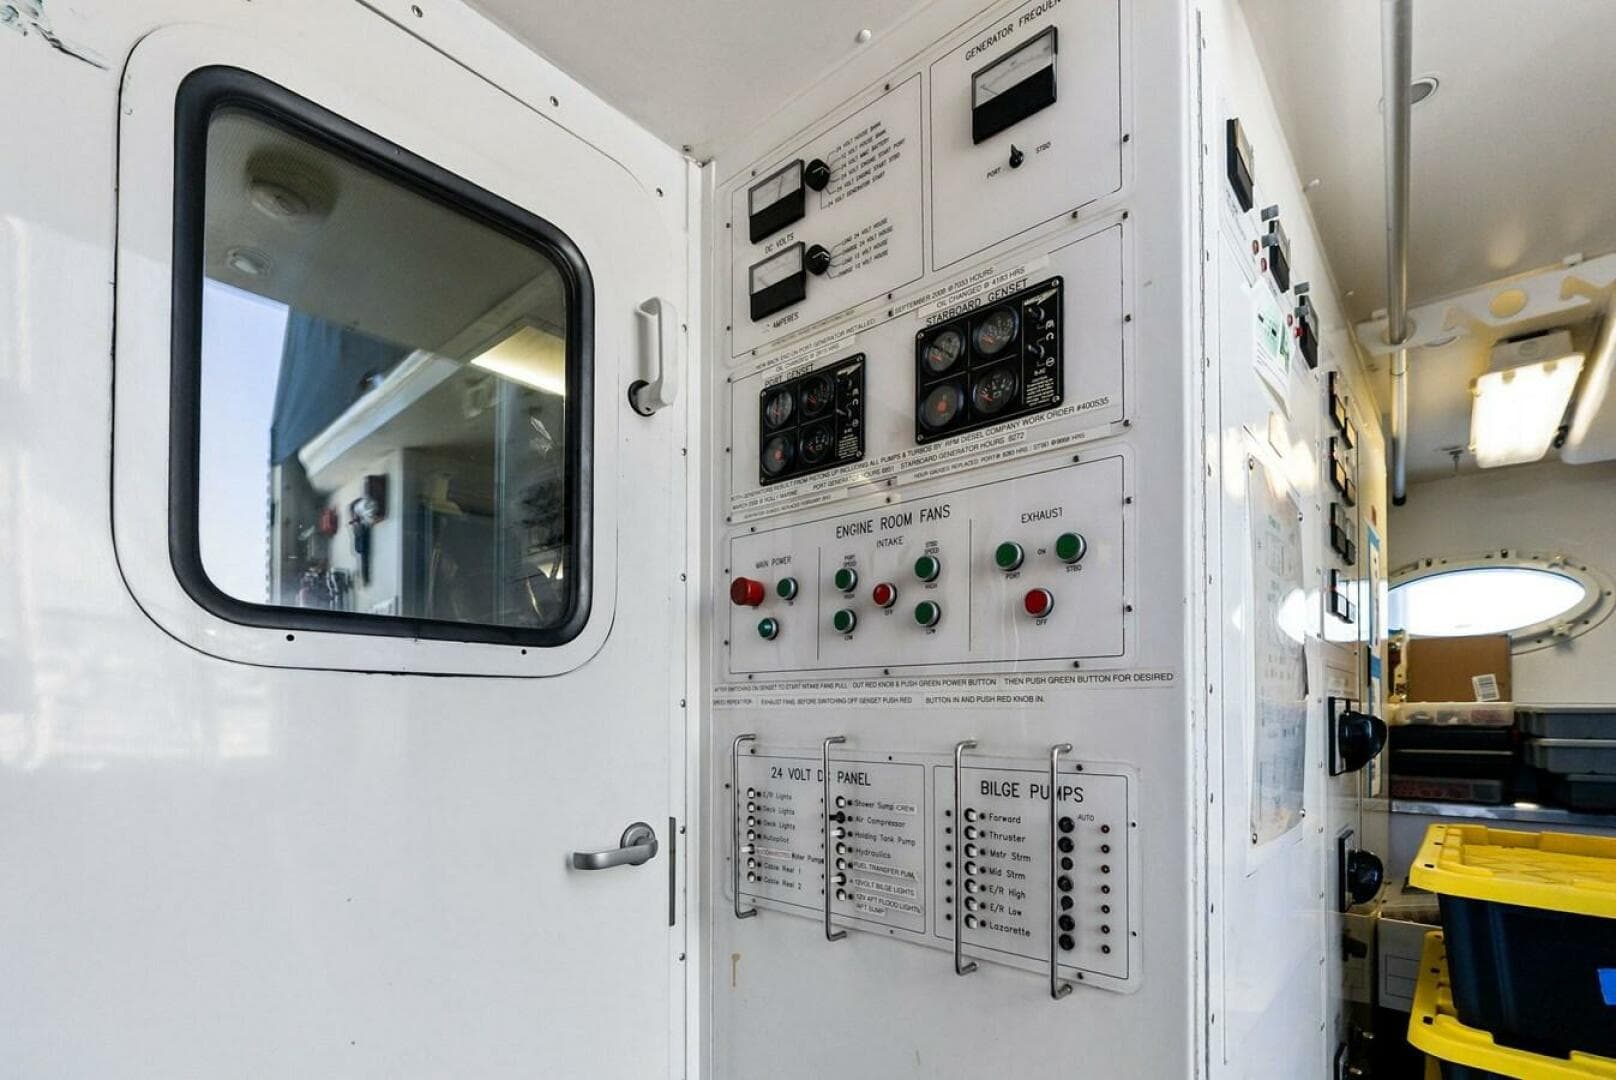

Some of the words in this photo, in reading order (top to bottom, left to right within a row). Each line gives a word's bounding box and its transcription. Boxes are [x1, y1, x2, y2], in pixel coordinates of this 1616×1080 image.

[966, 24, 1014, 61] GENERATOR
[764, 244, 773, 254] DC
[776, 233, 794, 248] VOLTS
[948, 284, 982, 303] CHANGED
[1009, 266, 1025, 277] HRS
[926, 298, 981, 326] STARBOARD
[988, 278, 1028, 301] GENSET
[773, 312, 799, 329] AMPERES
[814, 331, 845, 348] GENERATOR
[765, 374, 782, 388] PORT
[786, 363, 814, 380] GENSET
[880, 452, 901, 462] PUMPS
[985, 421, 1020, 435] COMPANY
[1022, 414, 1045, 426] WORK
[1046, 405, 1074, 419] ORDER
[900, 454, 937, 468] STARBOARD
[938, 443, 979, 459] GENERATOR
[980, 437, 1004, 449] HOURS
[836, 519, 874, 539] ENGINE
[880, 512, 912, 532] ROOM
[920, 504, 950, 523] FANS
[1021, 507, 1063, 524] EXHAUST
[876, 536, 904, 548] INTAKE
[771, 555, 792, 566] POWER
[1077, 675, 1110, 683] BUTTON
[1112, 673, 1131, 681] FOR
[1134, 672, 1173, 681] DESIRED
[771, 766, 784, 779] 24
[788, 768, 811, 781] VOLT
[818, 769, 830, 783] D
[837, 770, 871, 786] PANEL
[776, 792, 792, 800] Lights
[980, 780, 1020, 798] BILGE
[779, 808, 794, 816] Lights
[854, 799, 874, 808] Shower
[877, 802, 893, 811] Sump
[867, 817, 906, 828] Compressor
[990, 813, 1021, 824] Forward
[1078, 814, 1094, 822] AUTO
[780, 822, 795, 830] Lights
[764, 834, 789, 843] Autopilot
[855, 832, 877, 842] Holding
[898, 836, 916, 847] Pump
[990, 831, 1026, 842] Thruster
[856, 848, 891, 858] Hydraulics
[990, 849, 1007, 858] Mstr
[1011, 852, 1031, 862] Strm
[764, 862, 779, 870] Cable
[854, 861, 866, 869] FUEL
[870, 863, 899, 875] TRANSFER
[990, 867, 1001, 876] Mid
[1007, 870, 1025, 880] Strm
[764, 876, 779, 884] Cable
[798, 882, 802, 890] 2
[876, 882, 891, 891] BILGE
[894, 887, 914, 896] LIGHTS
[990, 884, 1004, 896] E/R
[1009, 888, 1026, 900] High
[879, 898, 898, 908] FLOOD
[990, 902, 1004, 912] E/R
[1009, 907, 1022, 916] Low
[990, 920, 1031, 937] Lazarette
